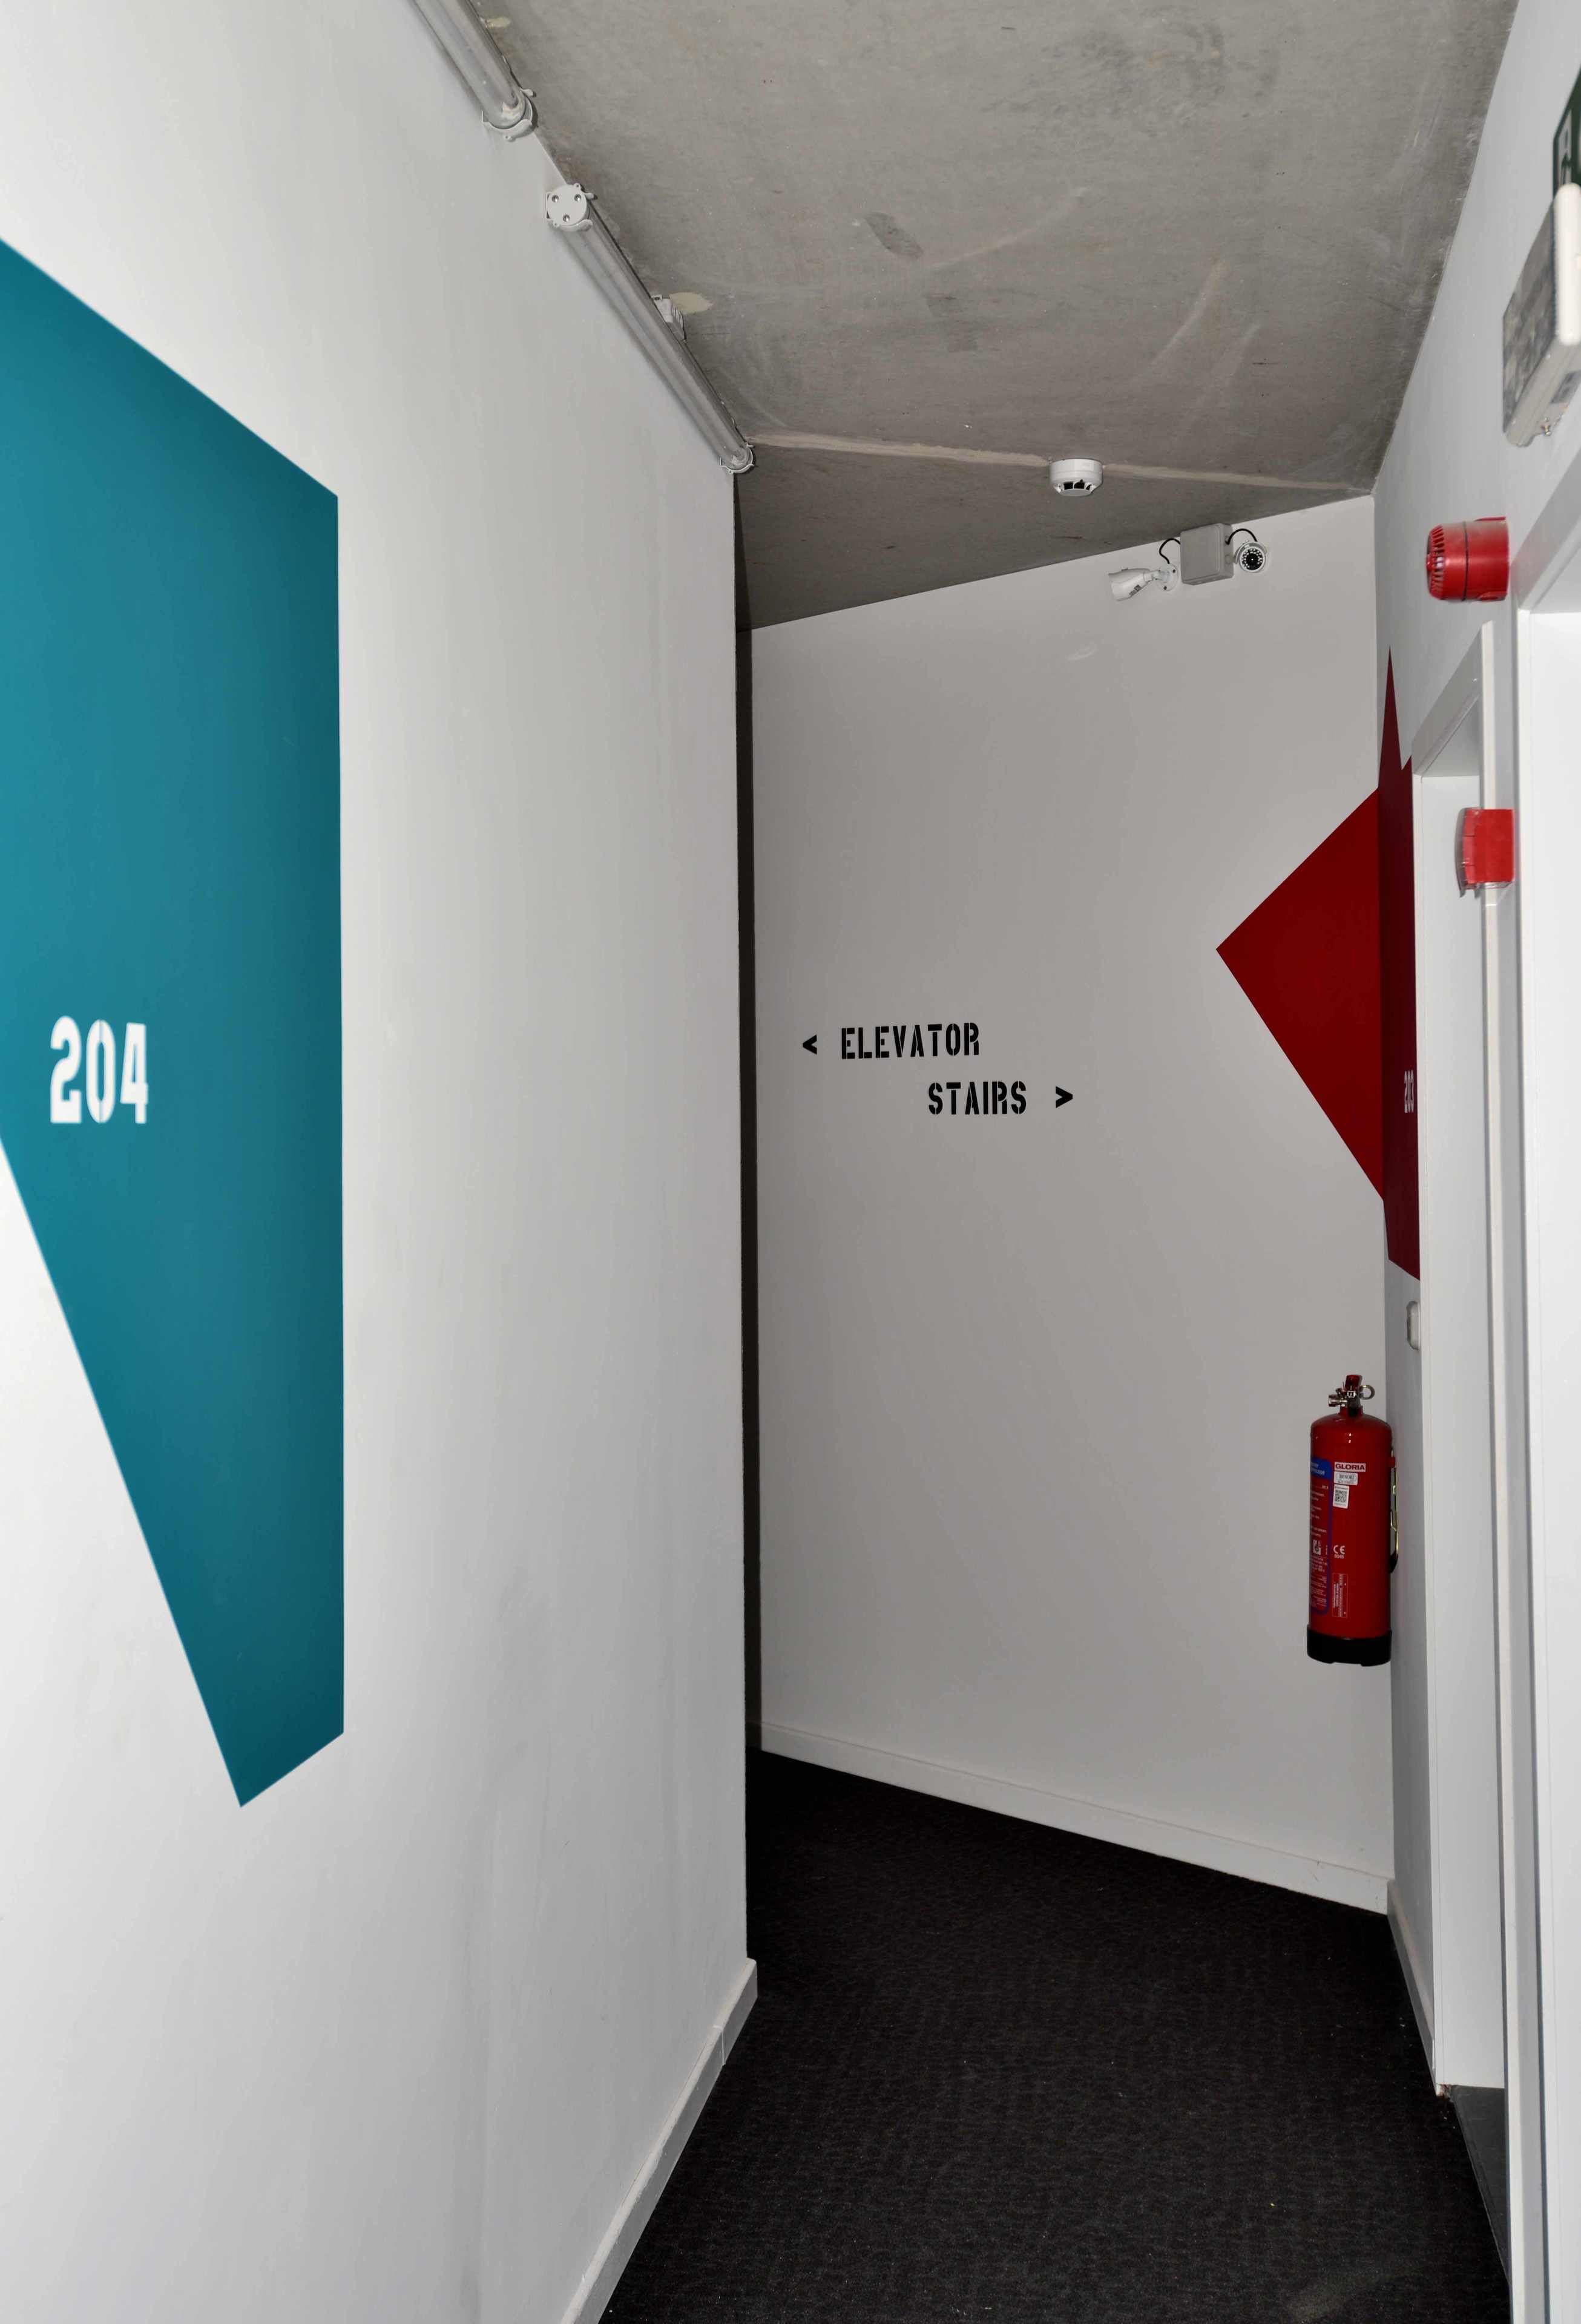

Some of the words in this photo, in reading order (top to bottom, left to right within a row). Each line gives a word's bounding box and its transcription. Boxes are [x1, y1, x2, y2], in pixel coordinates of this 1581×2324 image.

[841, 1022, 979, 1059] ELEVATOR
[51, 1016, 148, 1124] 204
[928, 1080, 1027, 1115] STAIRS
